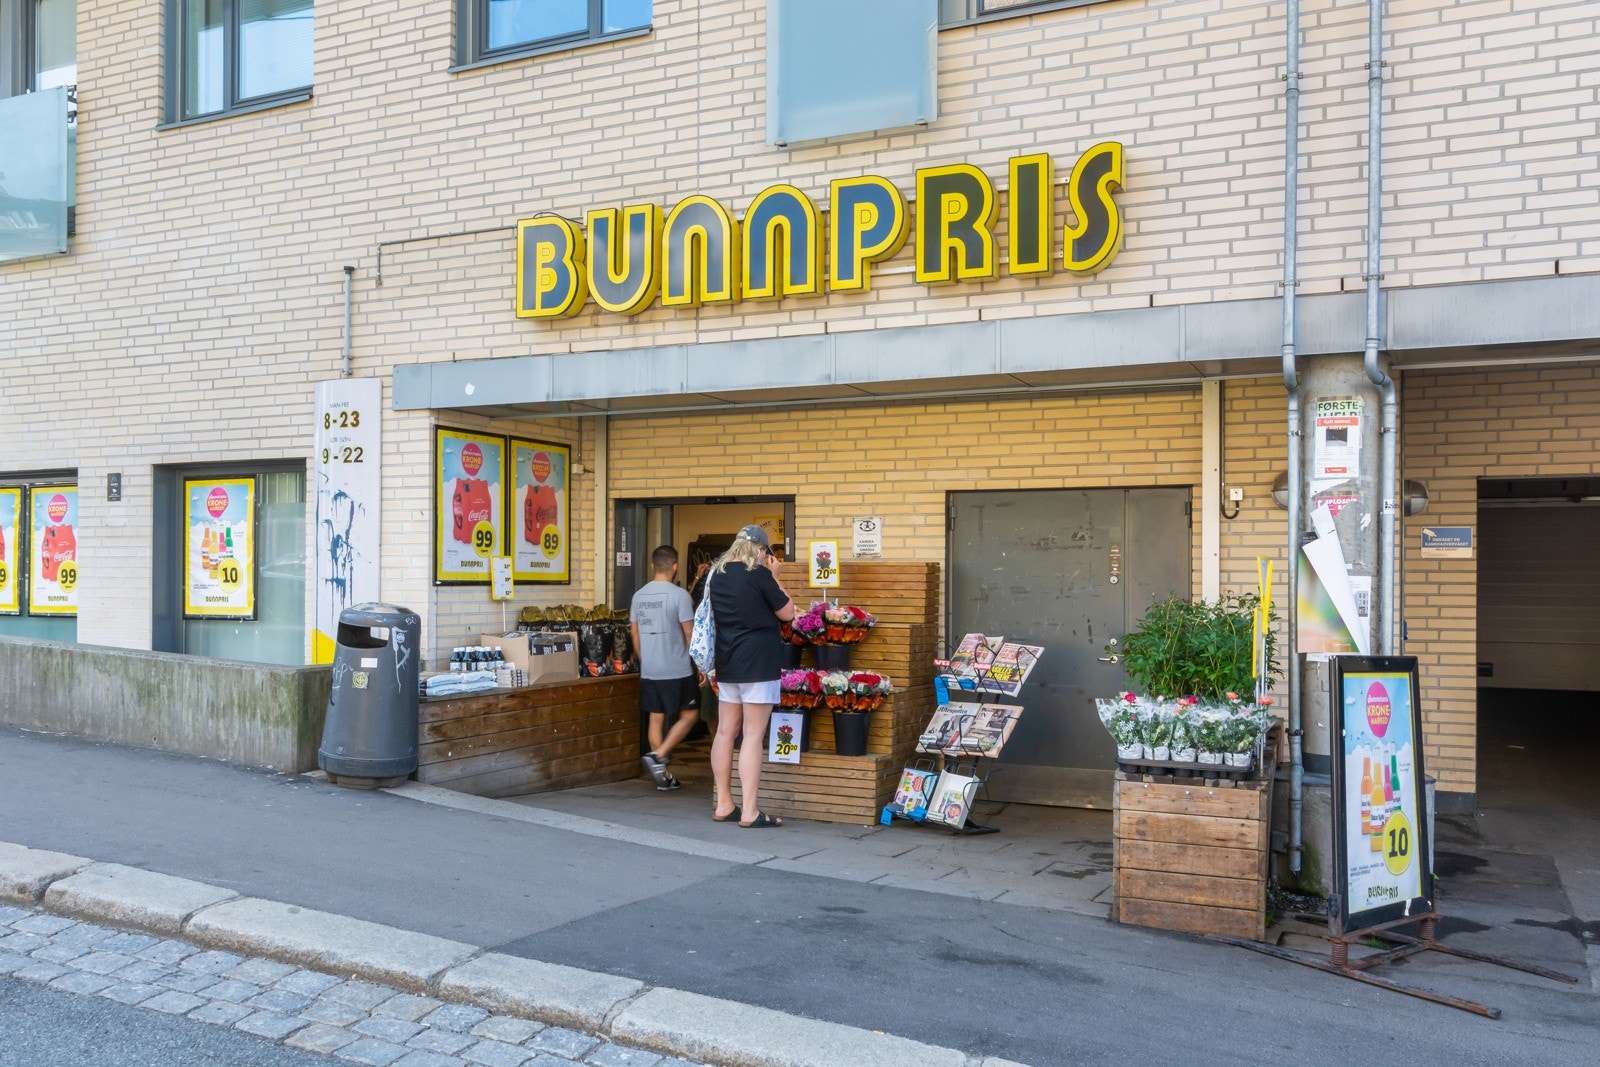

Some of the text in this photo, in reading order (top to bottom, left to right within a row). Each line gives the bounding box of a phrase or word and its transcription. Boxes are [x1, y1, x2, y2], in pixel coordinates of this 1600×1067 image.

[516, 142, 1125, 320] BUNNPRIS
[1318, 401, 1361, 411] FØRSTE-
[475, 530, 493, 548] 99
[543, 533, 559, 549] 89
[60, 568, 77, 584] 99
[222, 567, 238, 583] 10
[1388, 827, 1408, 858] 10
